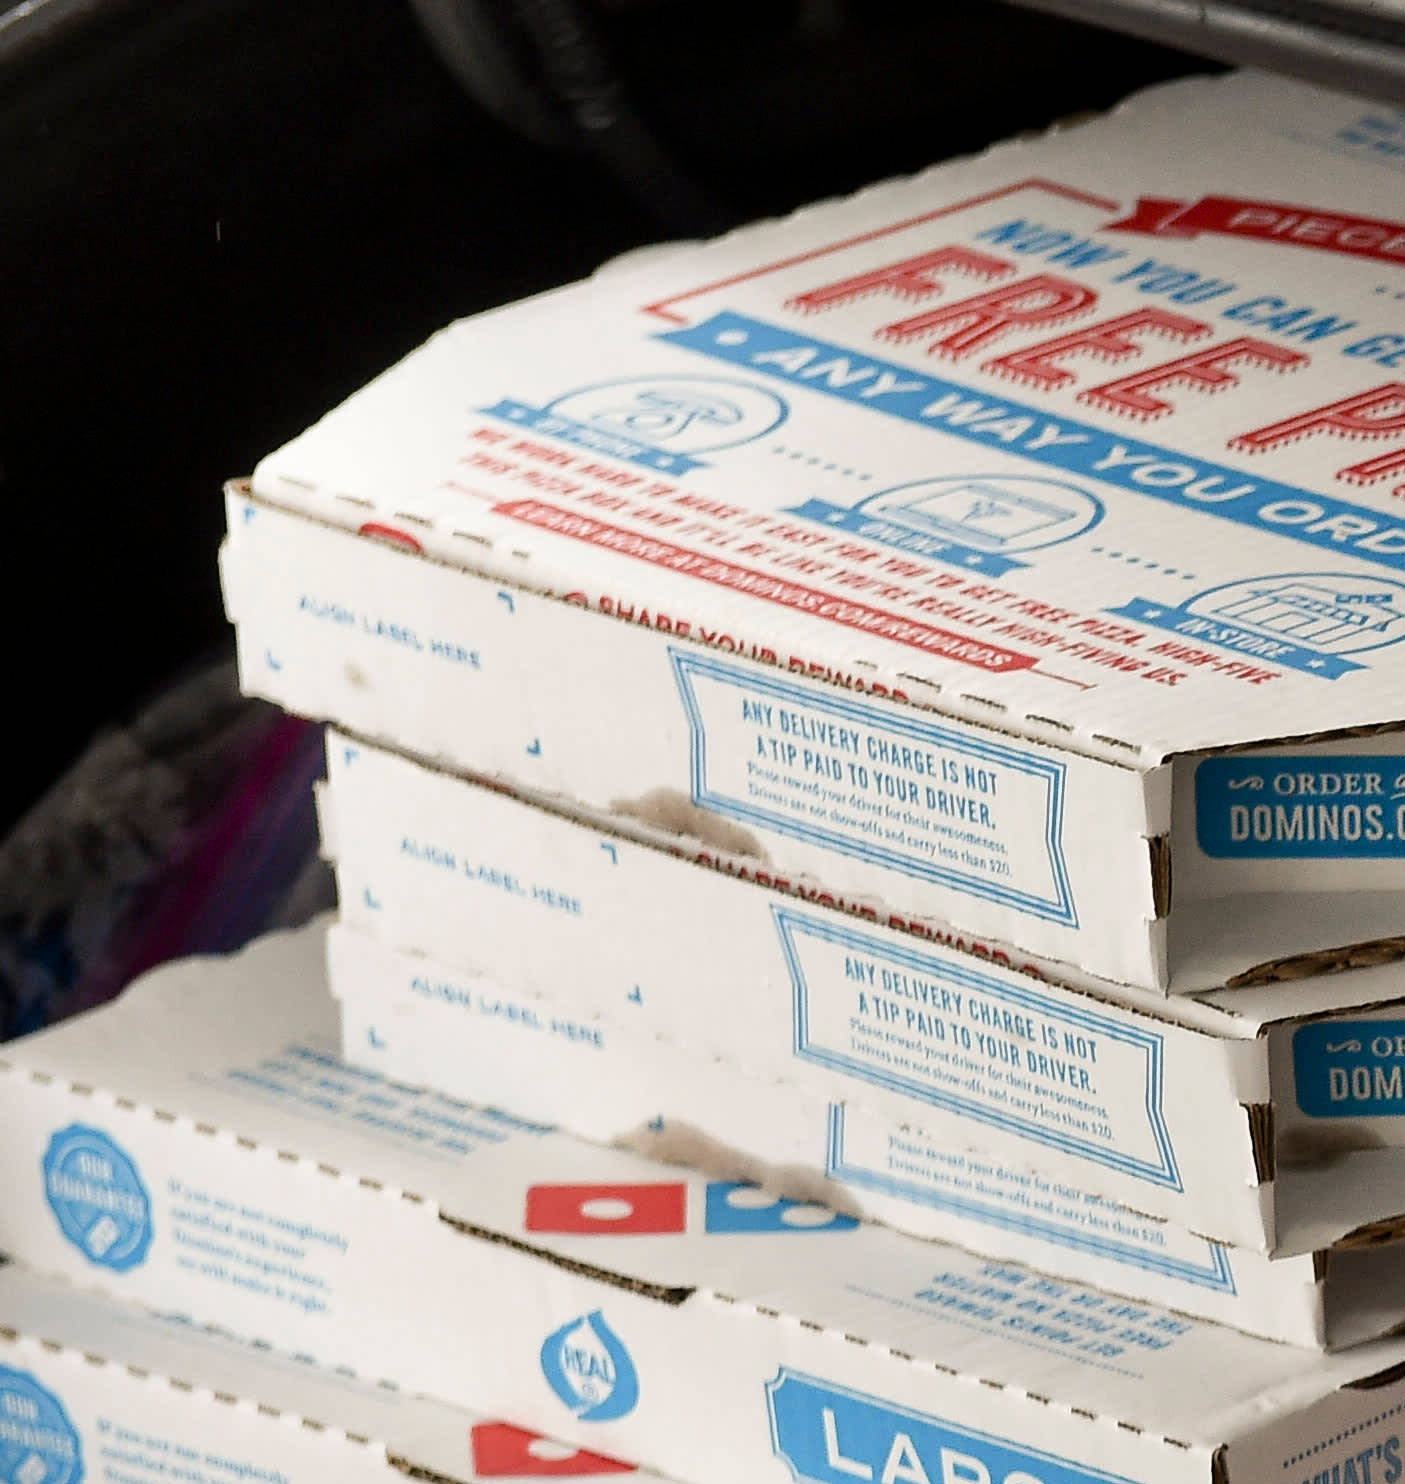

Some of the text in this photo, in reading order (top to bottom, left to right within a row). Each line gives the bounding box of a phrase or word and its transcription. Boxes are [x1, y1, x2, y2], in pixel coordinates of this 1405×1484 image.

[783, 247, 1311, 424] FREE
[977, 217, 1103, 274] NOW
[1114, 250, 1236, 305] YOU
[1225, 293, 1357, 344] CAN
[755, 345, 924, 398] ANY
[920, 393, 1086, 445] WAY
[1094, 445, 1255, 502] YOU
[1274, 773, 1384, 796] ORDER
